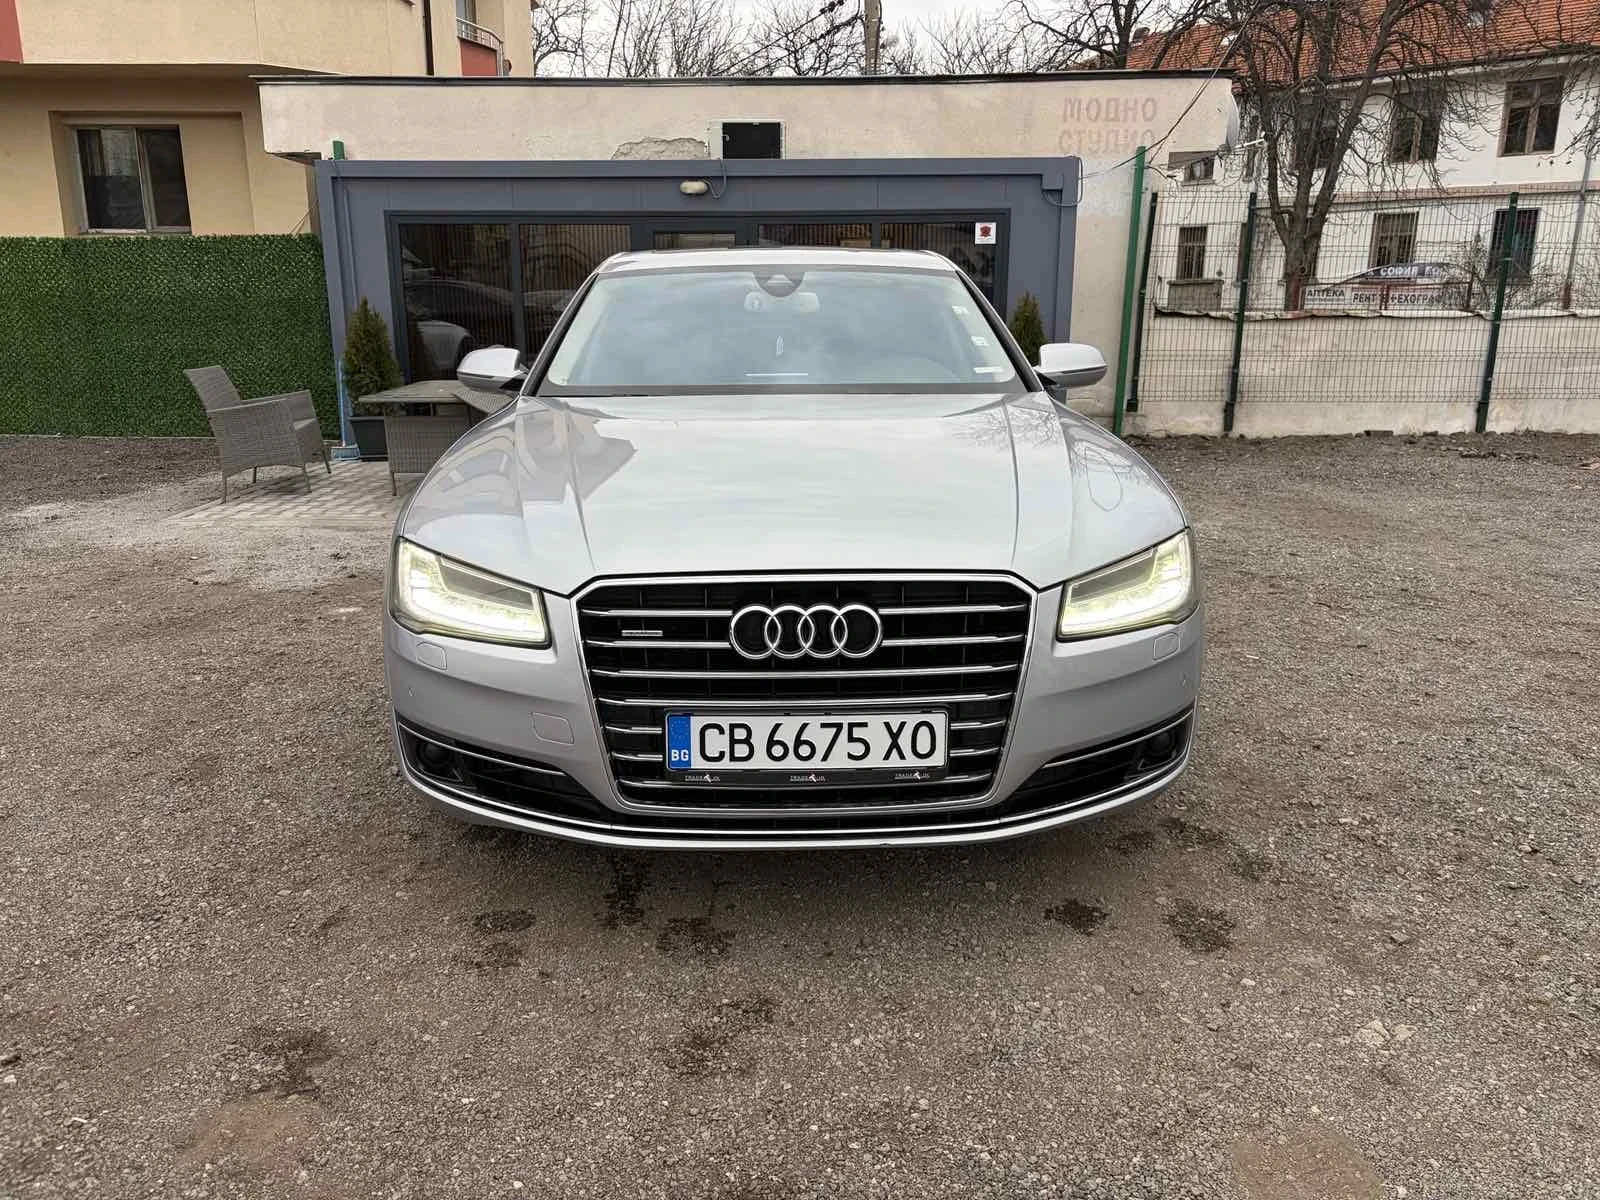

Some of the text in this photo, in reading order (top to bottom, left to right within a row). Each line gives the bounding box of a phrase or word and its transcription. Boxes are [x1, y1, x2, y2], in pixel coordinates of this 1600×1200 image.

[1062, 97, 1157, 122] МОДНО
[1306, 288, 1346, 298] АПТЕКА
[699, 720, 938, 763] CB 6675 XO
[671, 749, 690, 762] BG
